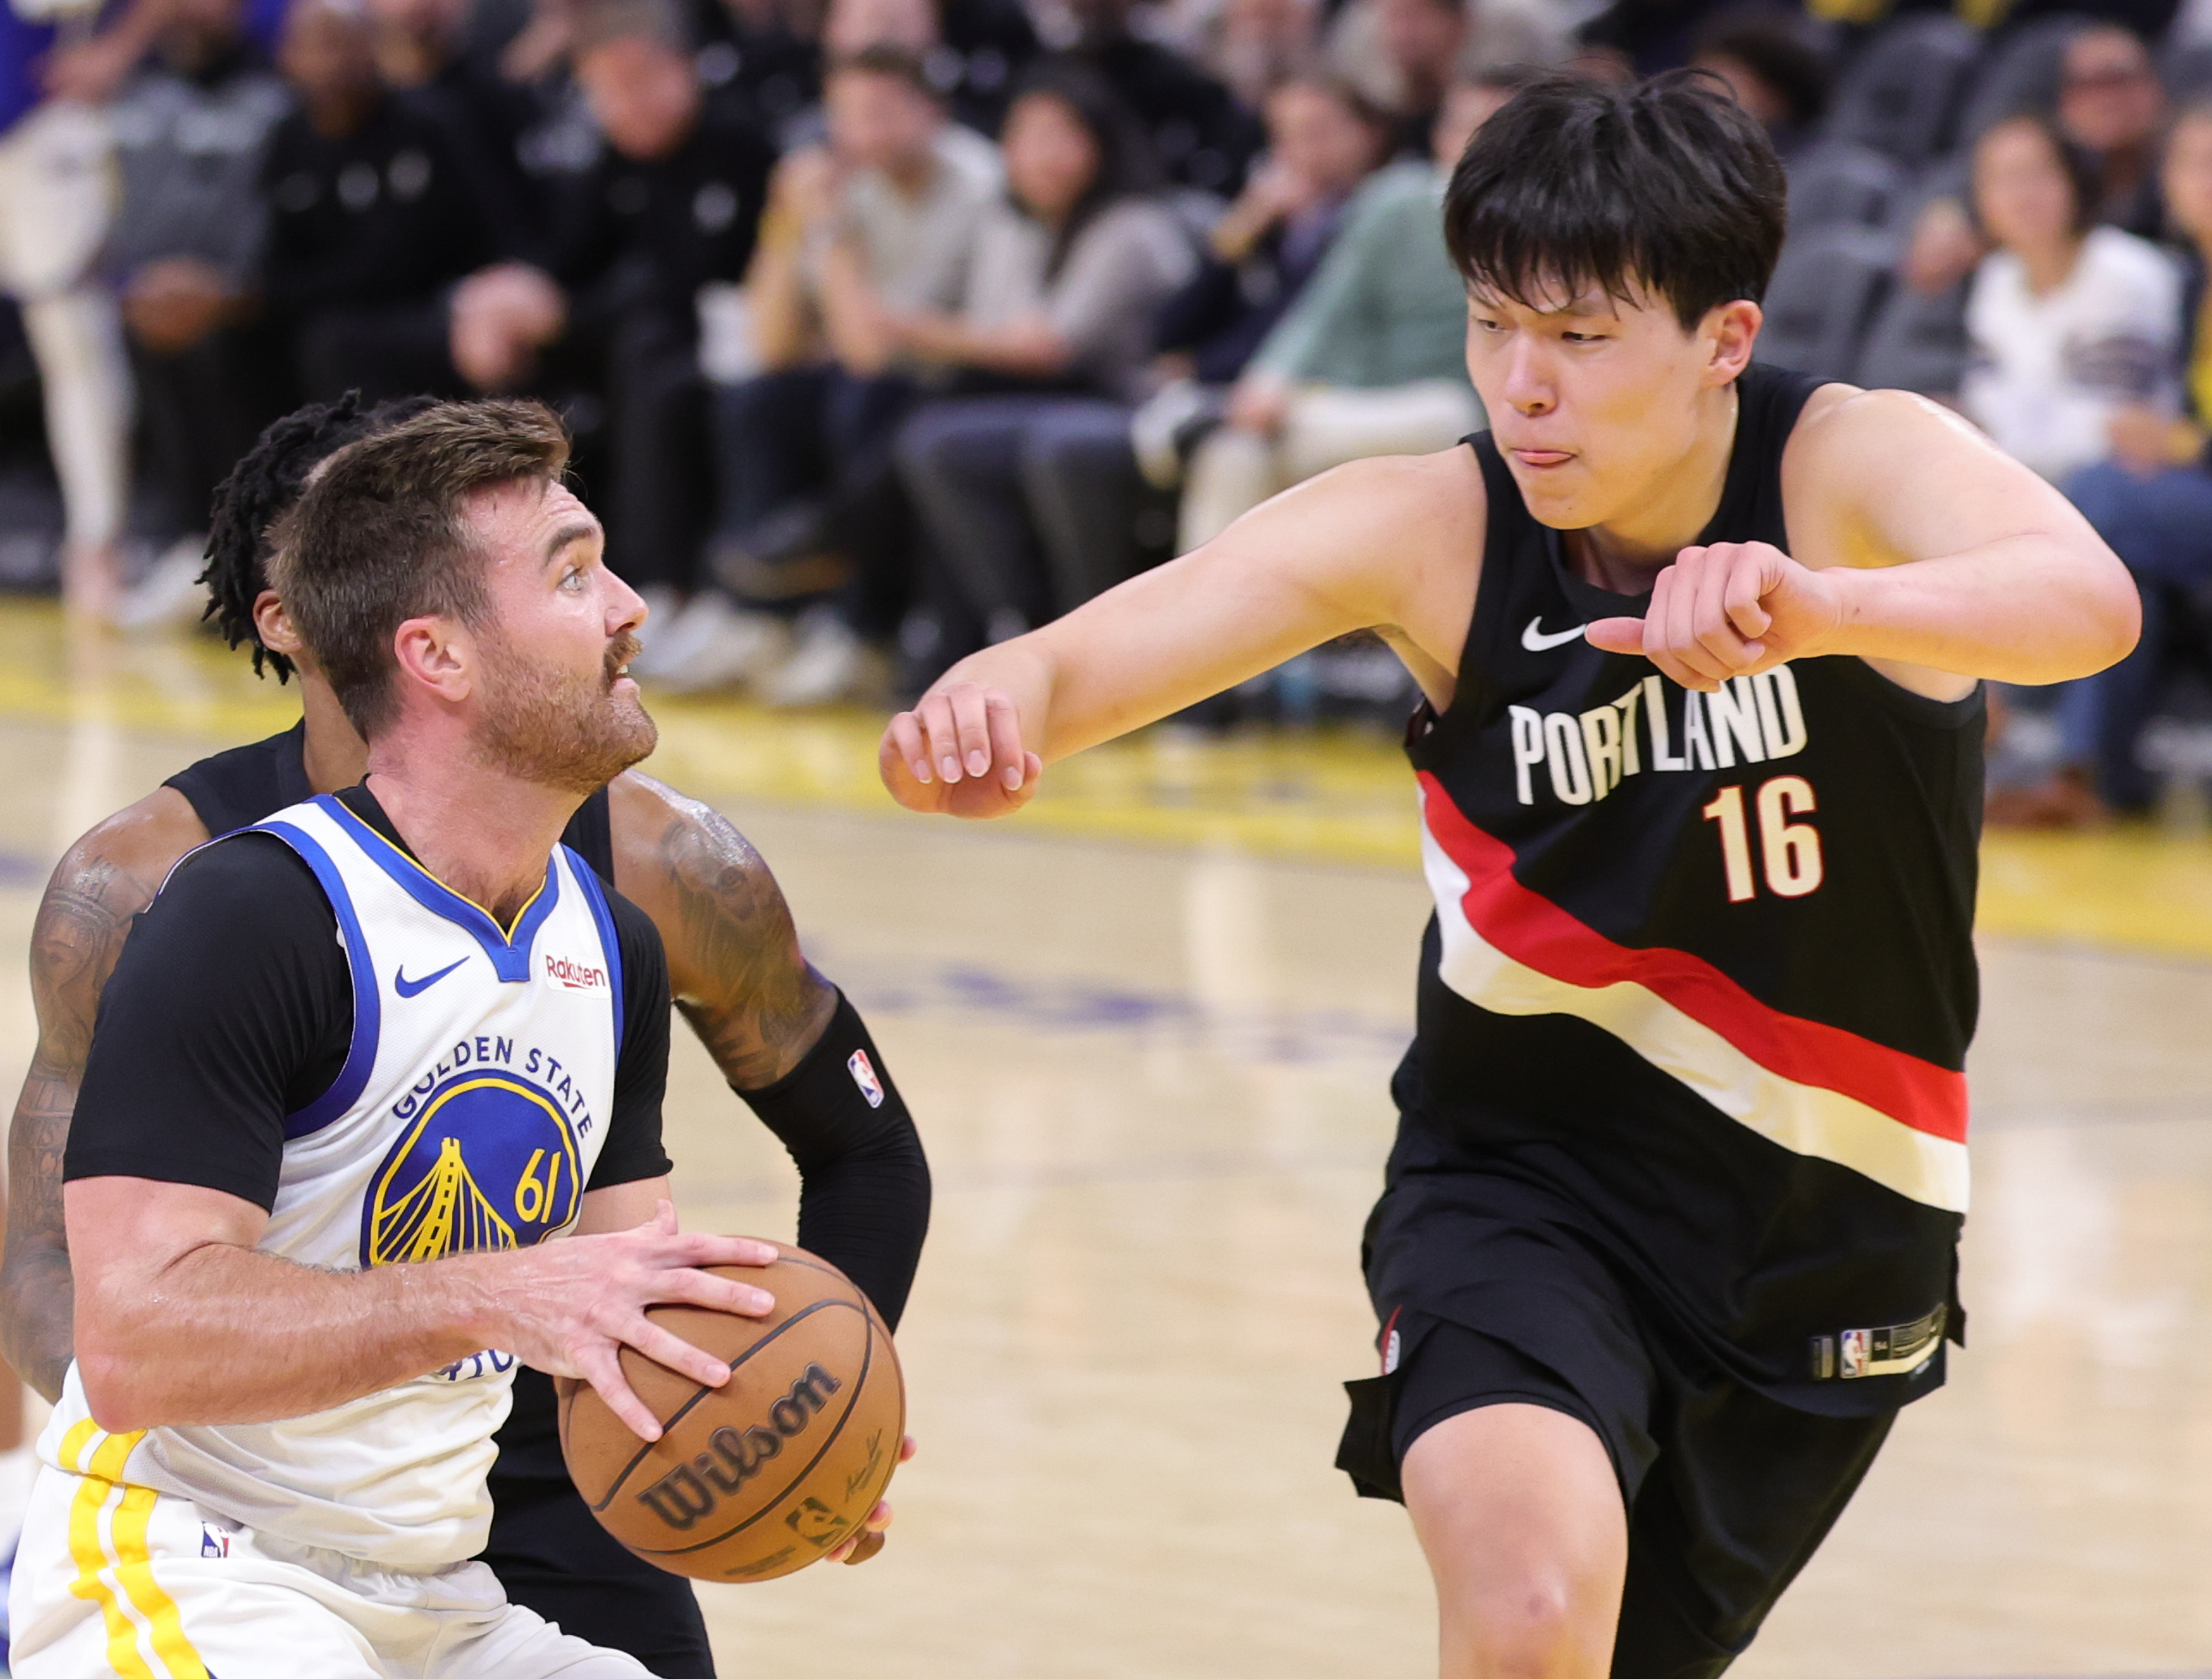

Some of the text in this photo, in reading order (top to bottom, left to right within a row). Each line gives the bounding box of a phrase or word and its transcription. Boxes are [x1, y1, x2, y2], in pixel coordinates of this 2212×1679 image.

[1508, 663, 1808, 806] PORTLAND
[1702, 774, 1825, 904] 16
[545, 954, 606, 987] Rakuten
[525, 1047, 593, 1139] STATE
[515, 1149, 561, 1224] 61
[637, 1362, 842, 1531] Wilson
[202, 1545, 219, 1558] NBA
